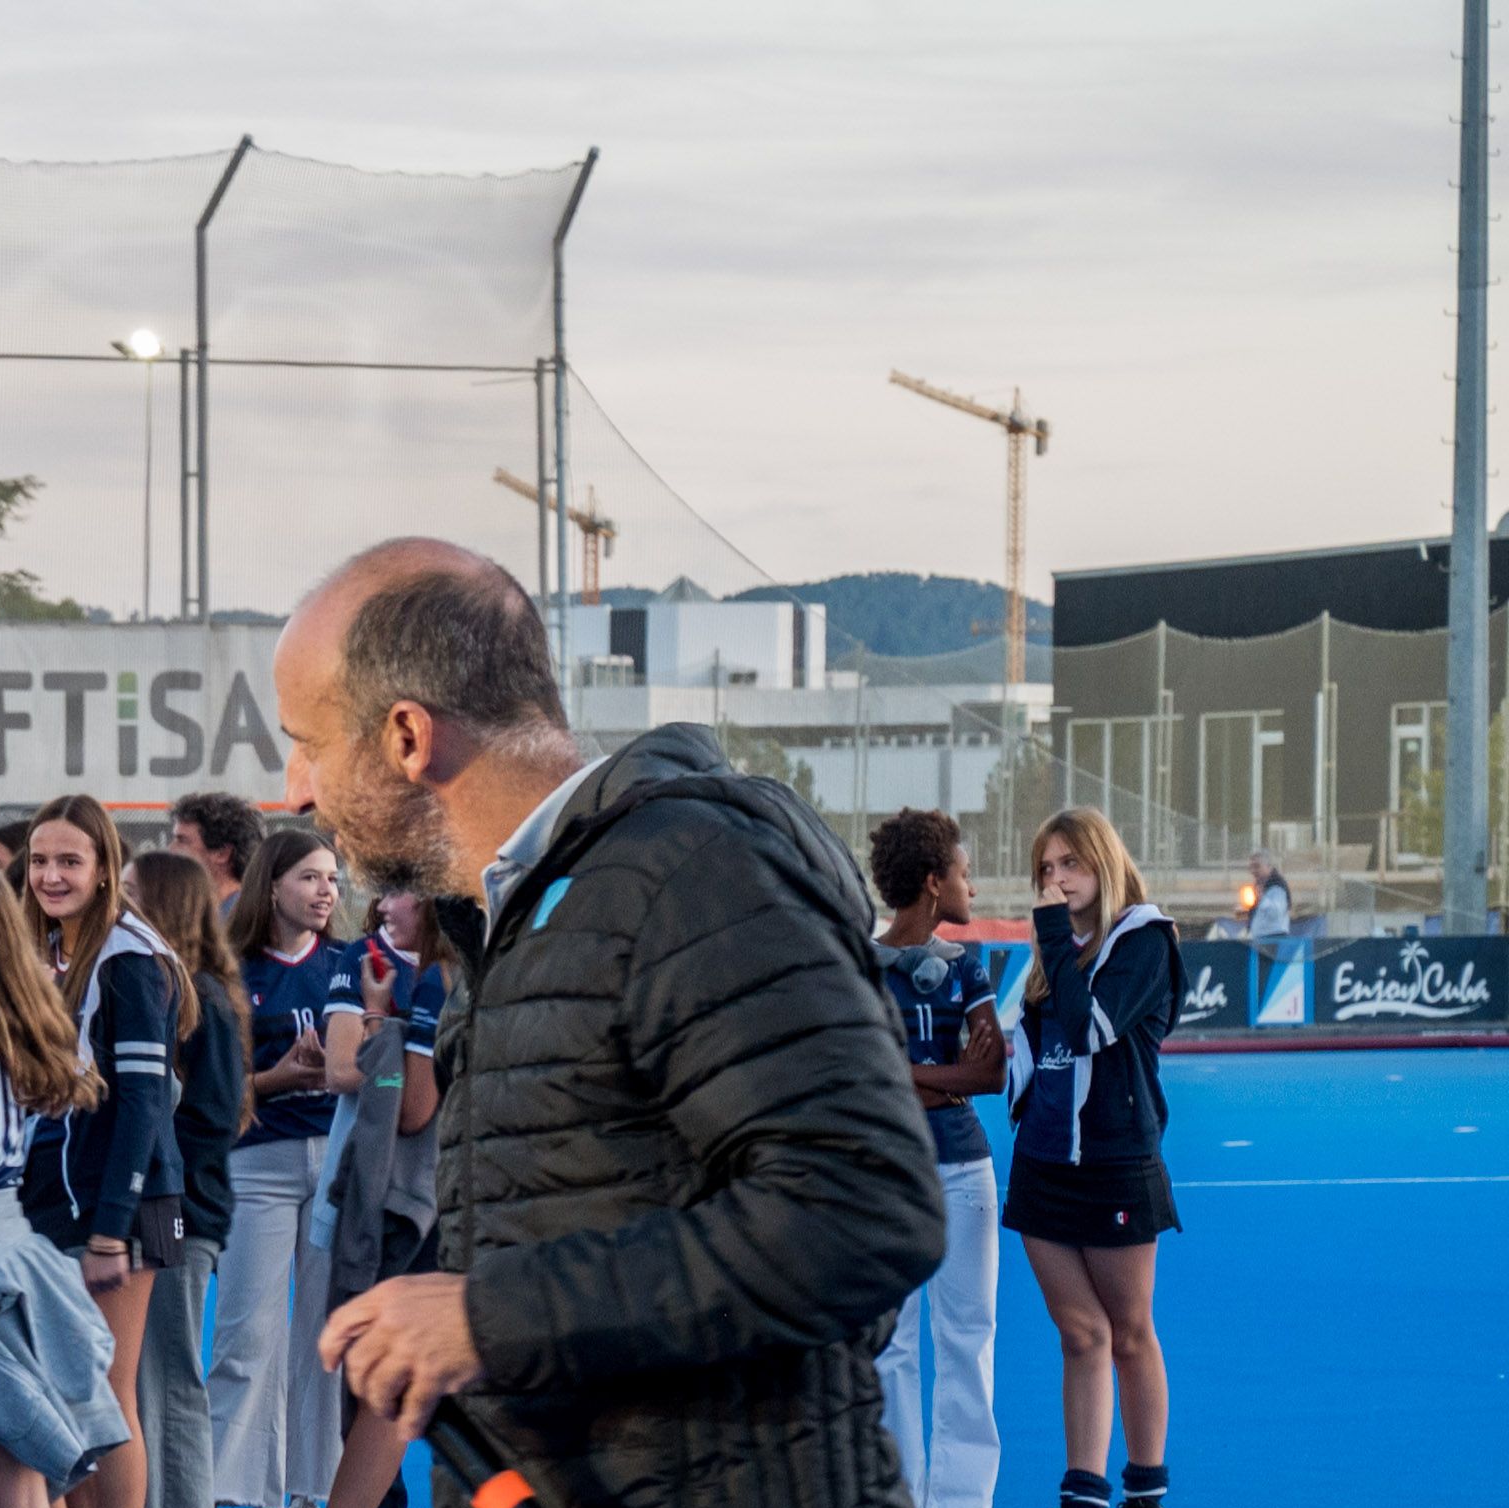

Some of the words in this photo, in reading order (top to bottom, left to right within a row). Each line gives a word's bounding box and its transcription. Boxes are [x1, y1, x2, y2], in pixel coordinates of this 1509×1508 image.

[1334, 960, 1420, 1003] Enjoy
[1421, 960, 1490, 1003] Cuba
[916, 1003, 933, 1041] 11
